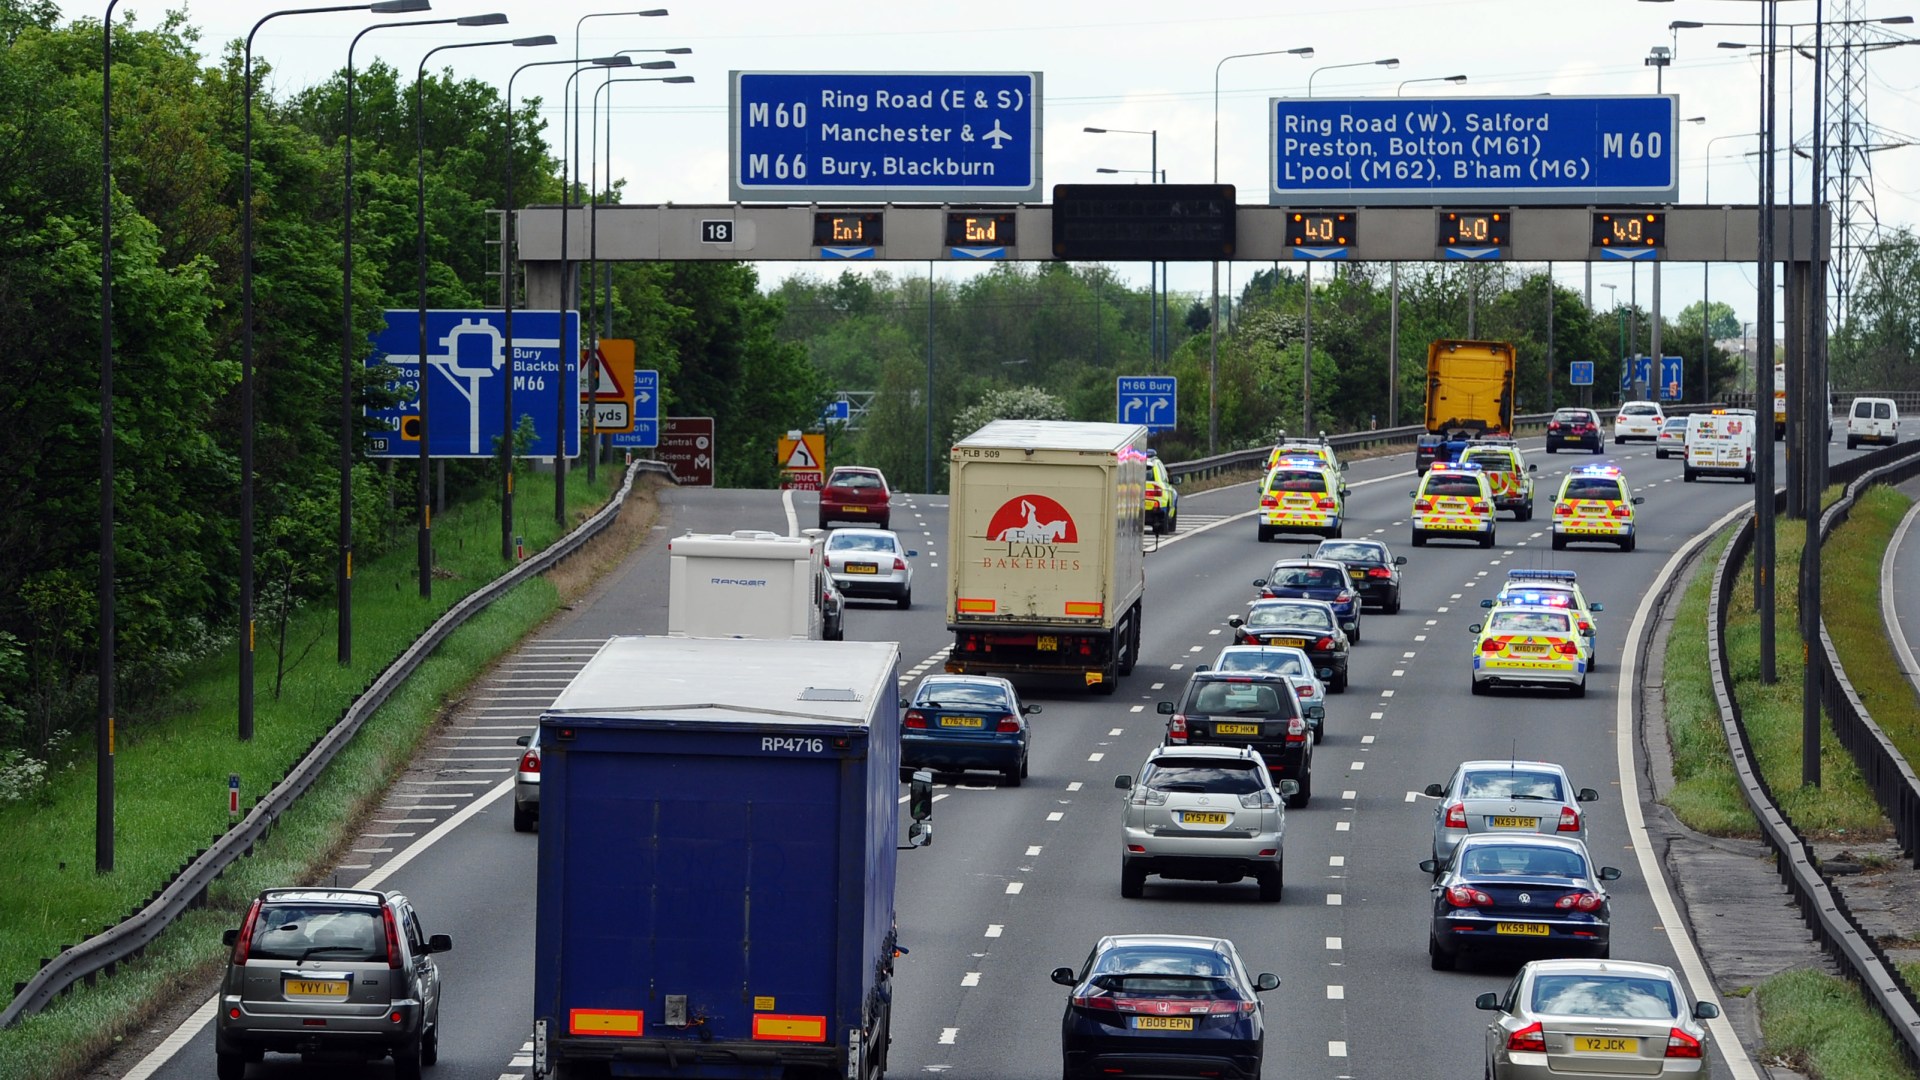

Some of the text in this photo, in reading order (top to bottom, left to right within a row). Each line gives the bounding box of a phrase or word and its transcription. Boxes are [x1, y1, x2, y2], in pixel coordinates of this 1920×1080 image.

[821, 88, 1024, 112] Ring Road (E & S)
[749, 102, 807, 128] M60
[1285, 111, 1549, 136] Ring Road (W), Salford
[821, 123, 975, 142] Manchester &
[1285, 135, 1542, 159] Preston, Bolton (M61)
[1603, 132, 1662, 159] M60
[749, 153, 807, 179] M66
[821, 157, 995, 179] Bury, Blackburn
[1285, 158, 1590, 183] L'pool (M62), B'ham (M6)
[708, 224, 727, 239] 18
[965, 218, 996, 240] End
[1305, 218, 1333, 240] 40
[1460, 217, 1487, 240] 40
[1614, 218, 1641, 241] 40
[513, 348, 541, 360] Bury
[398, 367, 420, 378] Roa
[513, 361, 575, 372] Blackbn
[513, 376, 545, 391] M66
[1123, 381, 1172, 392] M66 Bury
[399, 401, 407, 410] &
[598, 409, 622, 422] yds
[373, 440, 385, 449] 18
[616, 434, 641, 442] lanes
[985, 450, 1000, 458] 509
[1016, 530, 1050, 545] FINE
[1007, 541, 1058, 558] LADY
[983, 558, 1080, 570] BAKERIES
[711, 578, 767, 586] RANGER
[1219, 725, 1239, 733] LC57
[762, 737, 823, 752] RP4716
[1185, 813, 1225, 823] GY57 EWA
[1494, 817, 1535, 827] NX59 VSE
[1526, 924, 1545, 934] HNJ
[300, 983, 320, 993] YVY
[1139, 1018, 1191, 1028] YB08 EPN
[1587, 1039, 1625, 1050] Y2 JCK
